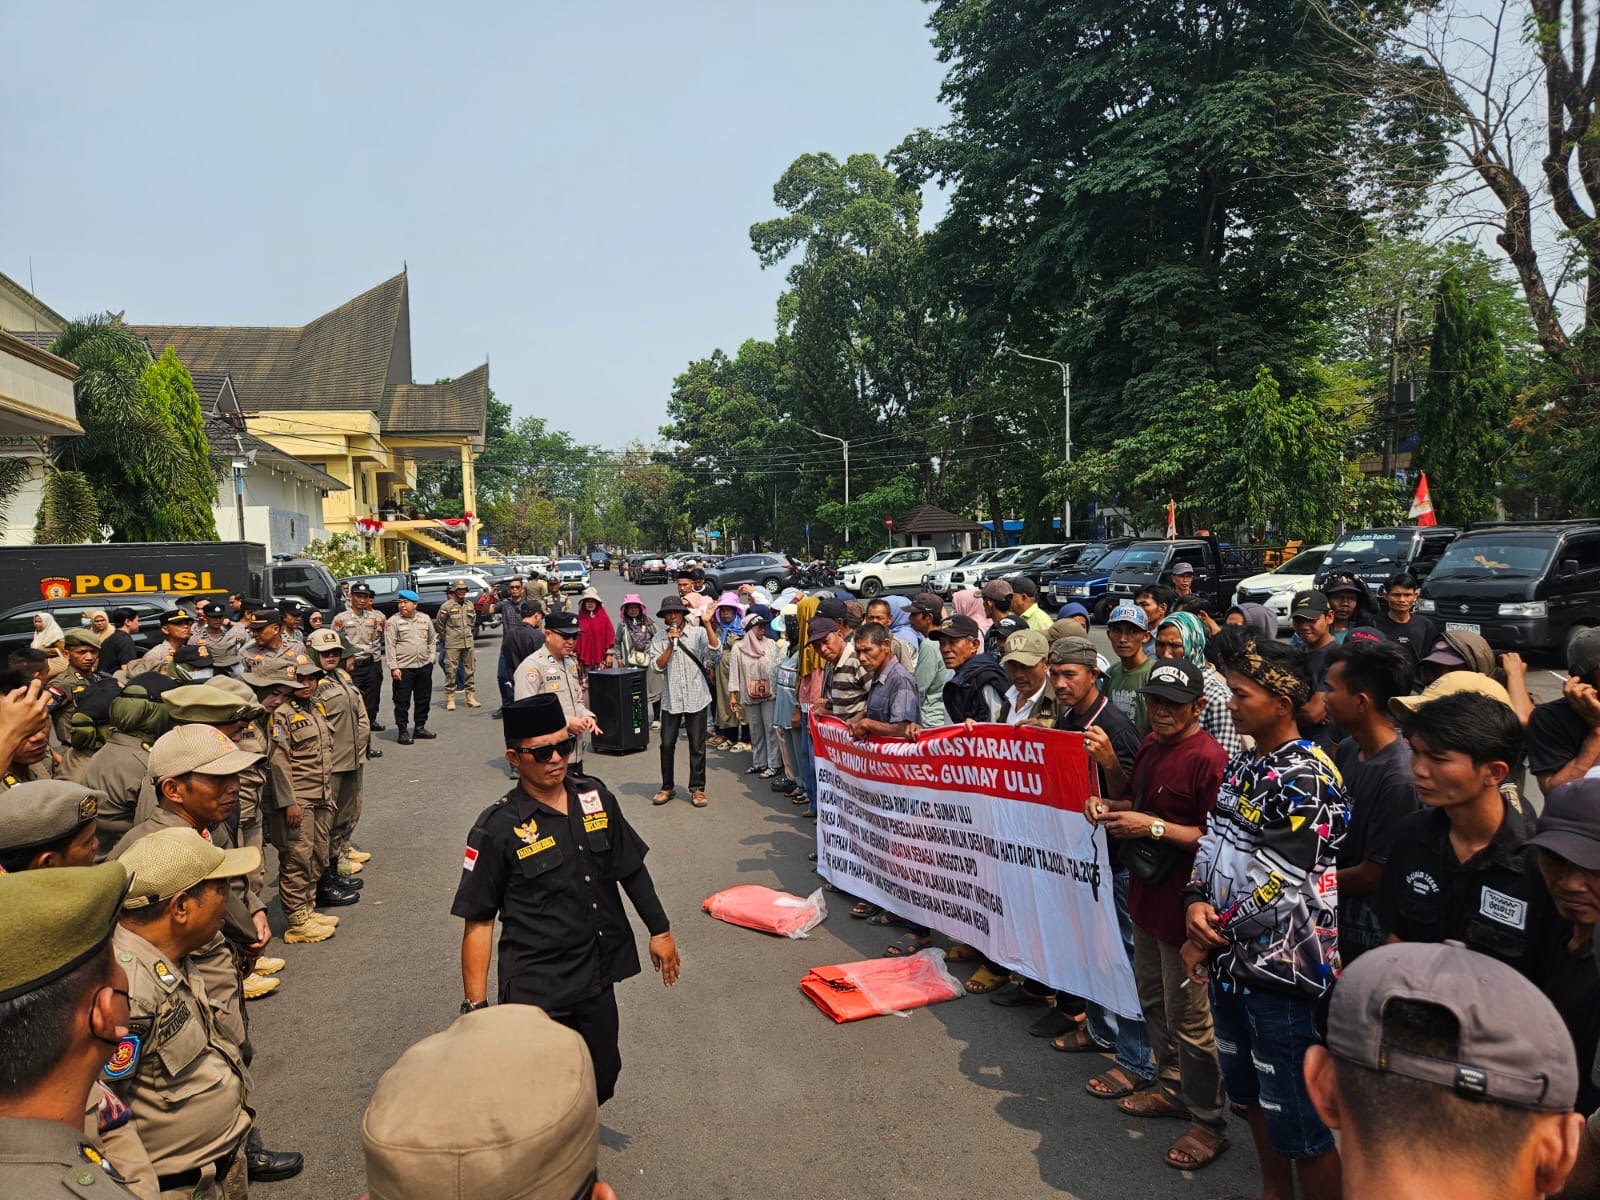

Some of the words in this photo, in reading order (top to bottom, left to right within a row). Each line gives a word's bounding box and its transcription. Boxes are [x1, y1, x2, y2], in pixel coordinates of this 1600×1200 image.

[76, 572, 212, 594] POLISI
[1010, 637, 1027, 650] W
[929, 737, 1045, 765] MASYARAKAT
[841, 752, 867, 775] RINDU
[868, 758, 901, 779] HATI
[941, 764, 999, 790] GUMAY
[1003, 768, 1044, 796] ULU
[933, 803, 958, 822] GUMAY
[957, 805, 973, 824] ULU
[935, 850, 966, 874] ANGGOTA
[967, 832, 984, 853] DESA
[1000, 841, 1018, 864] HATI
[1018, 845, 1036, 868] DARI
